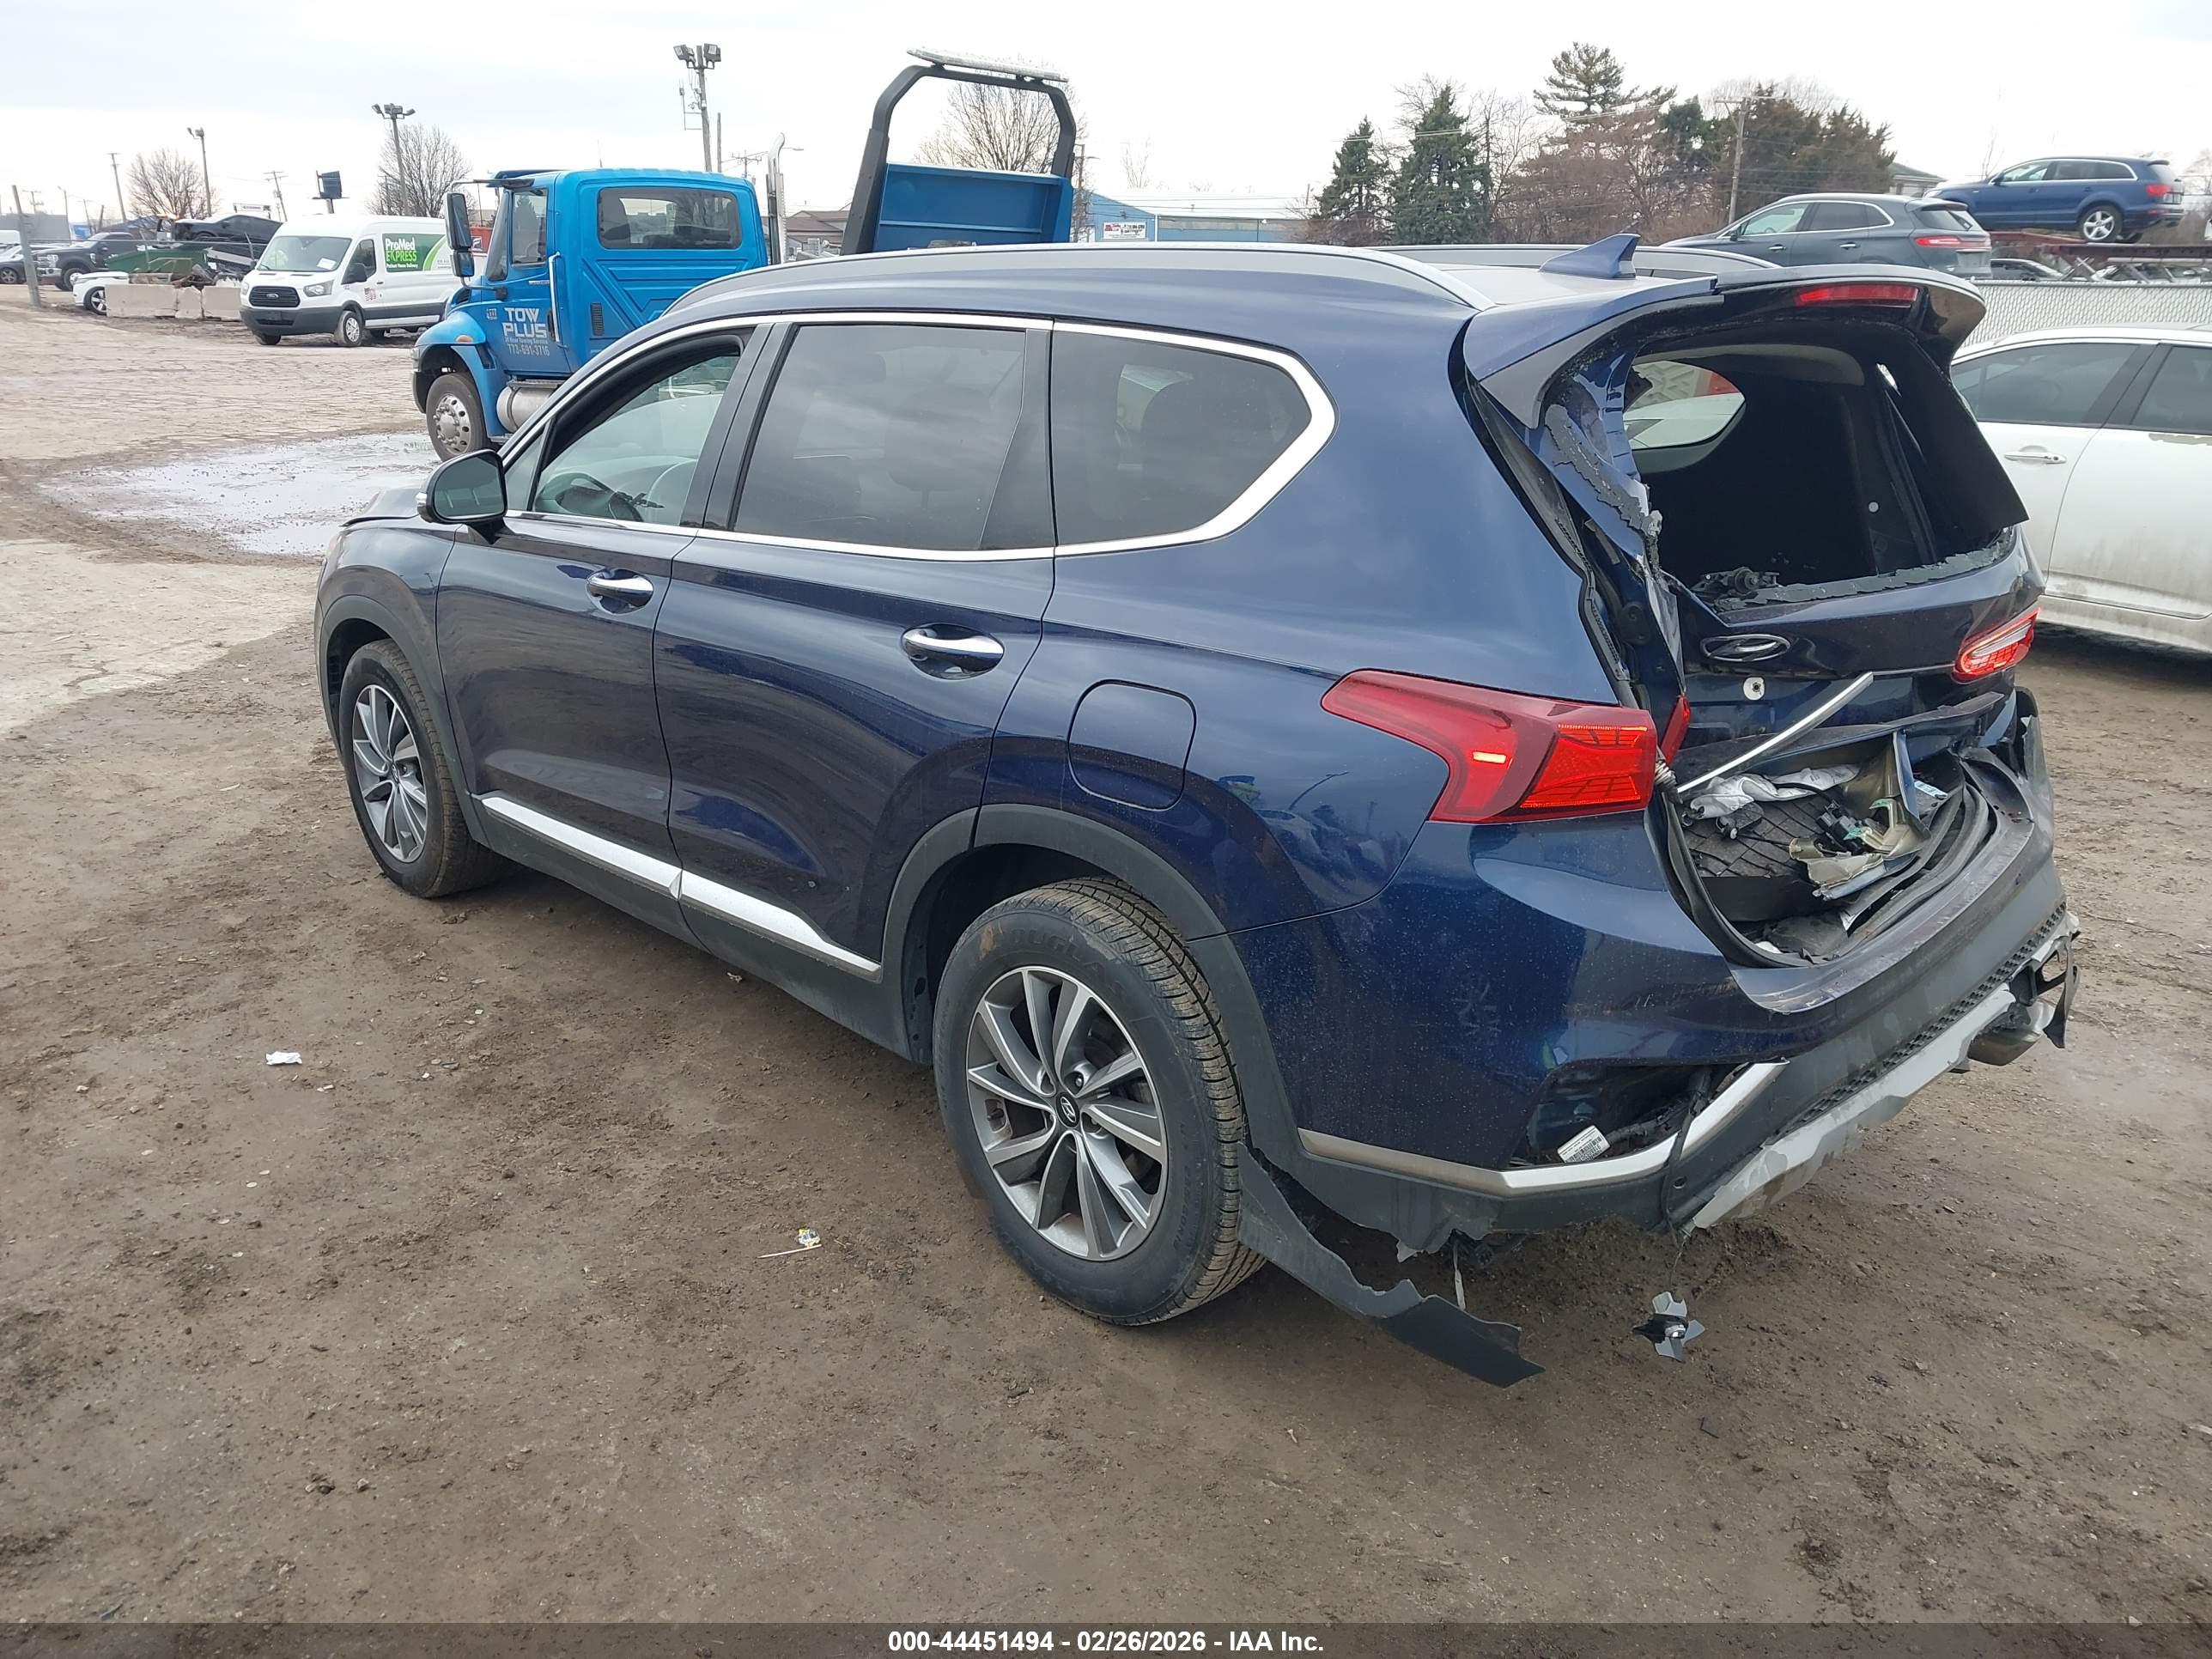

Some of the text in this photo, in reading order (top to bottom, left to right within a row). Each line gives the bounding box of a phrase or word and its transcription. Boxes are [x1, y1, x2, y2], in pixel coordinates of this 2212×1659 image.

[385, 236, 416, 251] ProMed
[504, 307, 540, 323] TOW
[501, 322, 547, 338] PLUS
